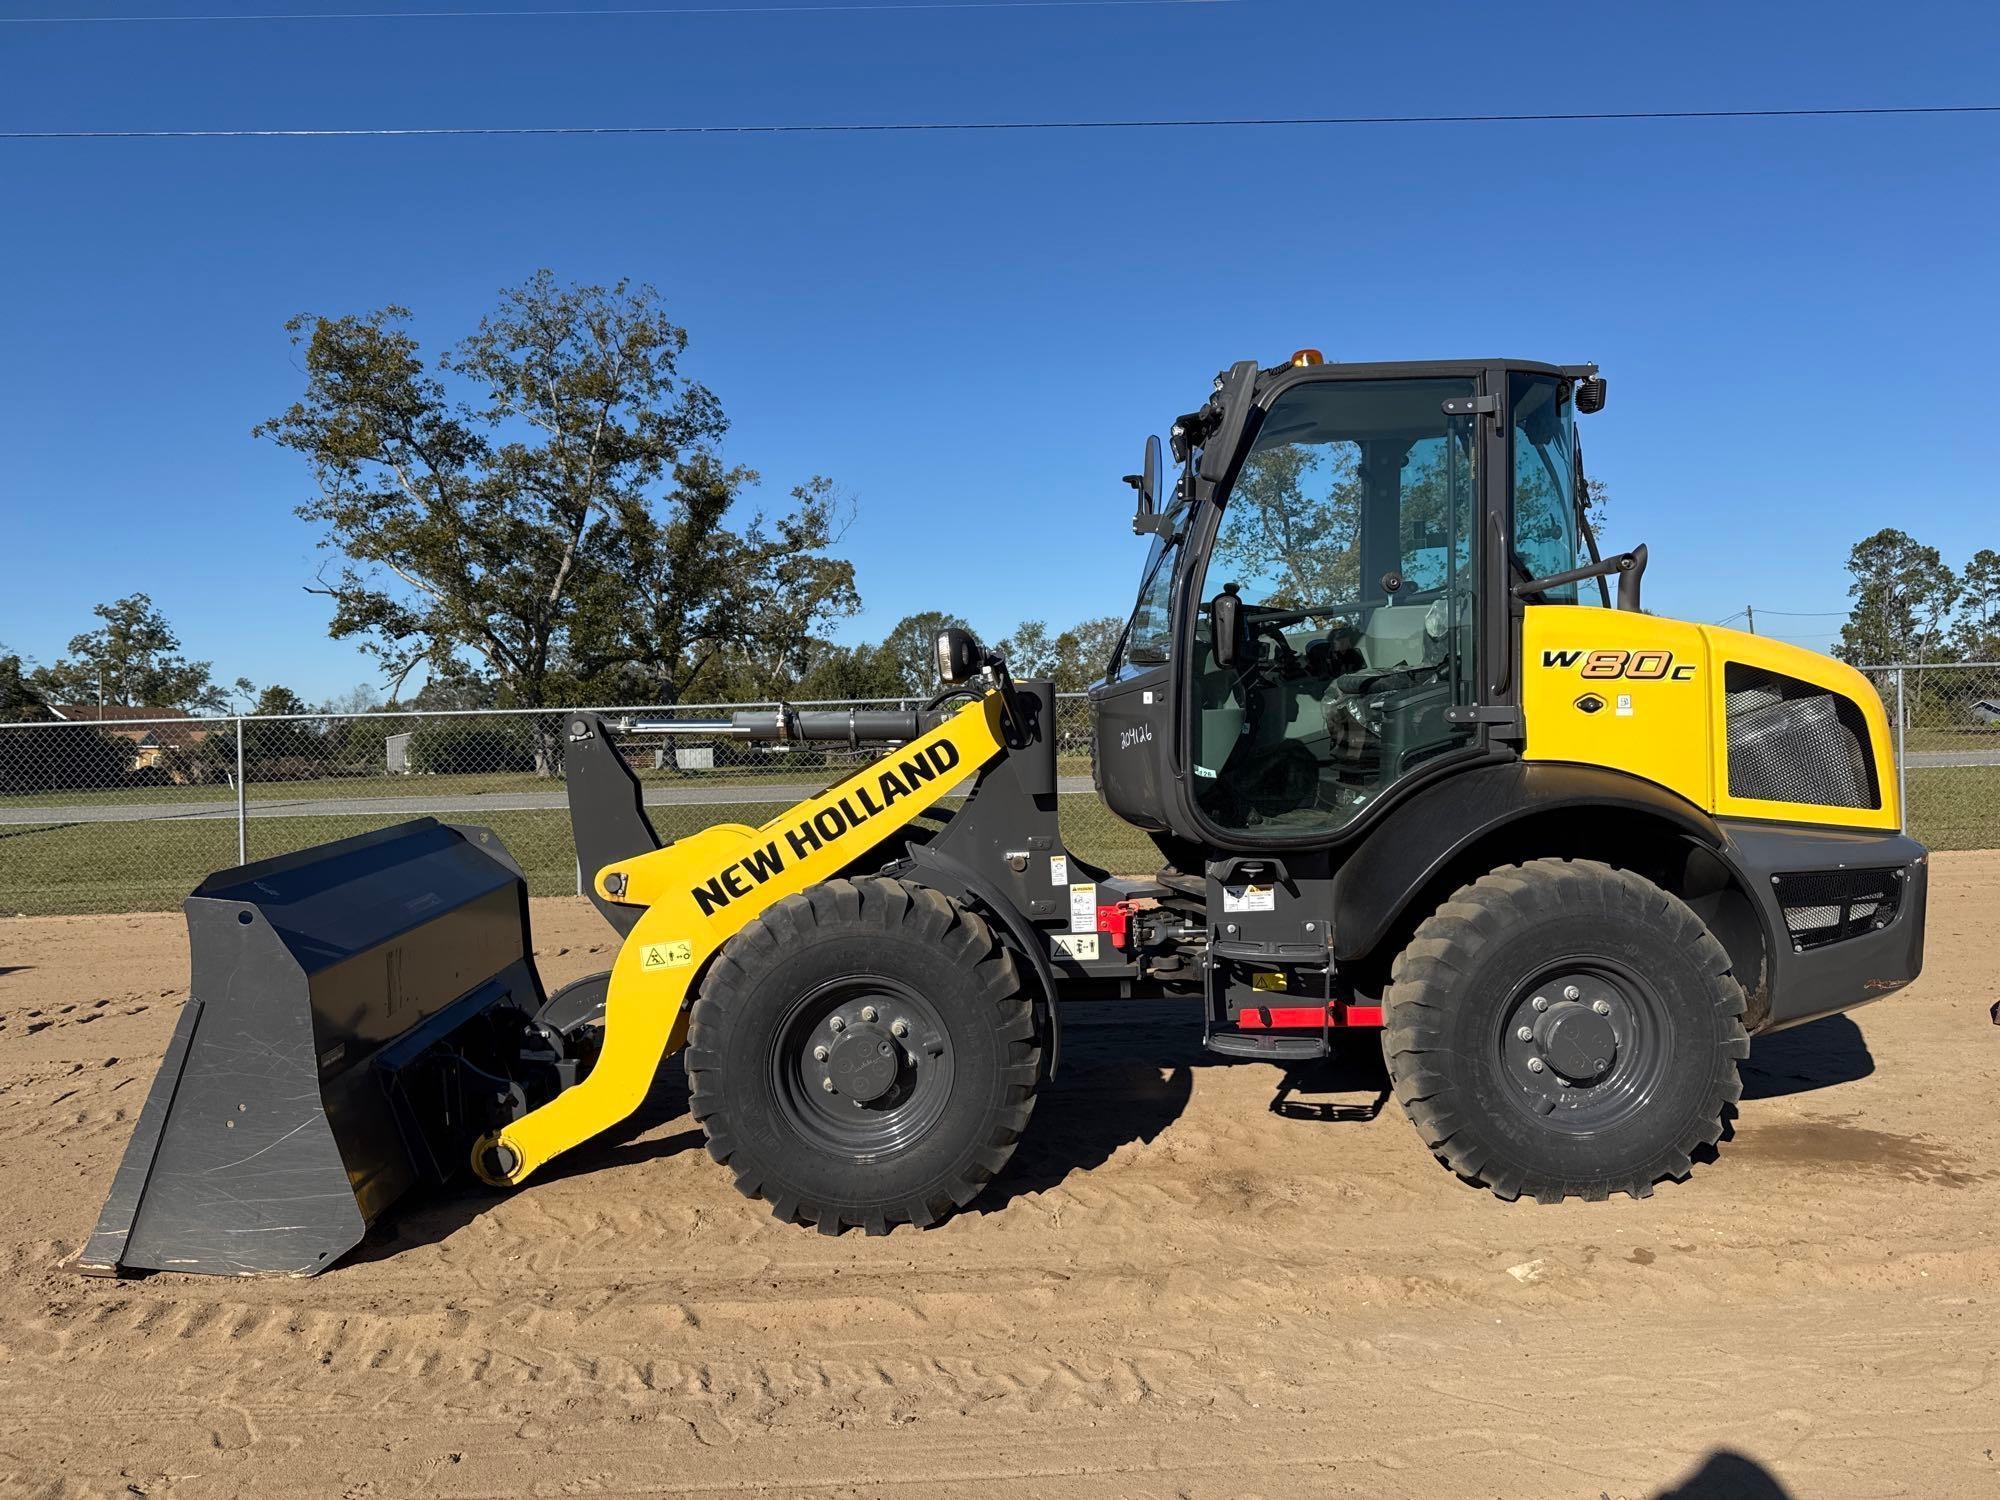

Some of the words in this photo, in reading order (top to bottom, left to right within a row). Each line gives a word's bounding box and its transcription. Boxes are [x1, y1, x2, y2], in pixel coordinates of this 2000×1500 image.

[1120, 723, 1152, 749] 204126
[691, 841, 785, 917] NEW
[784, 738, 960, 860] HOLLAND
